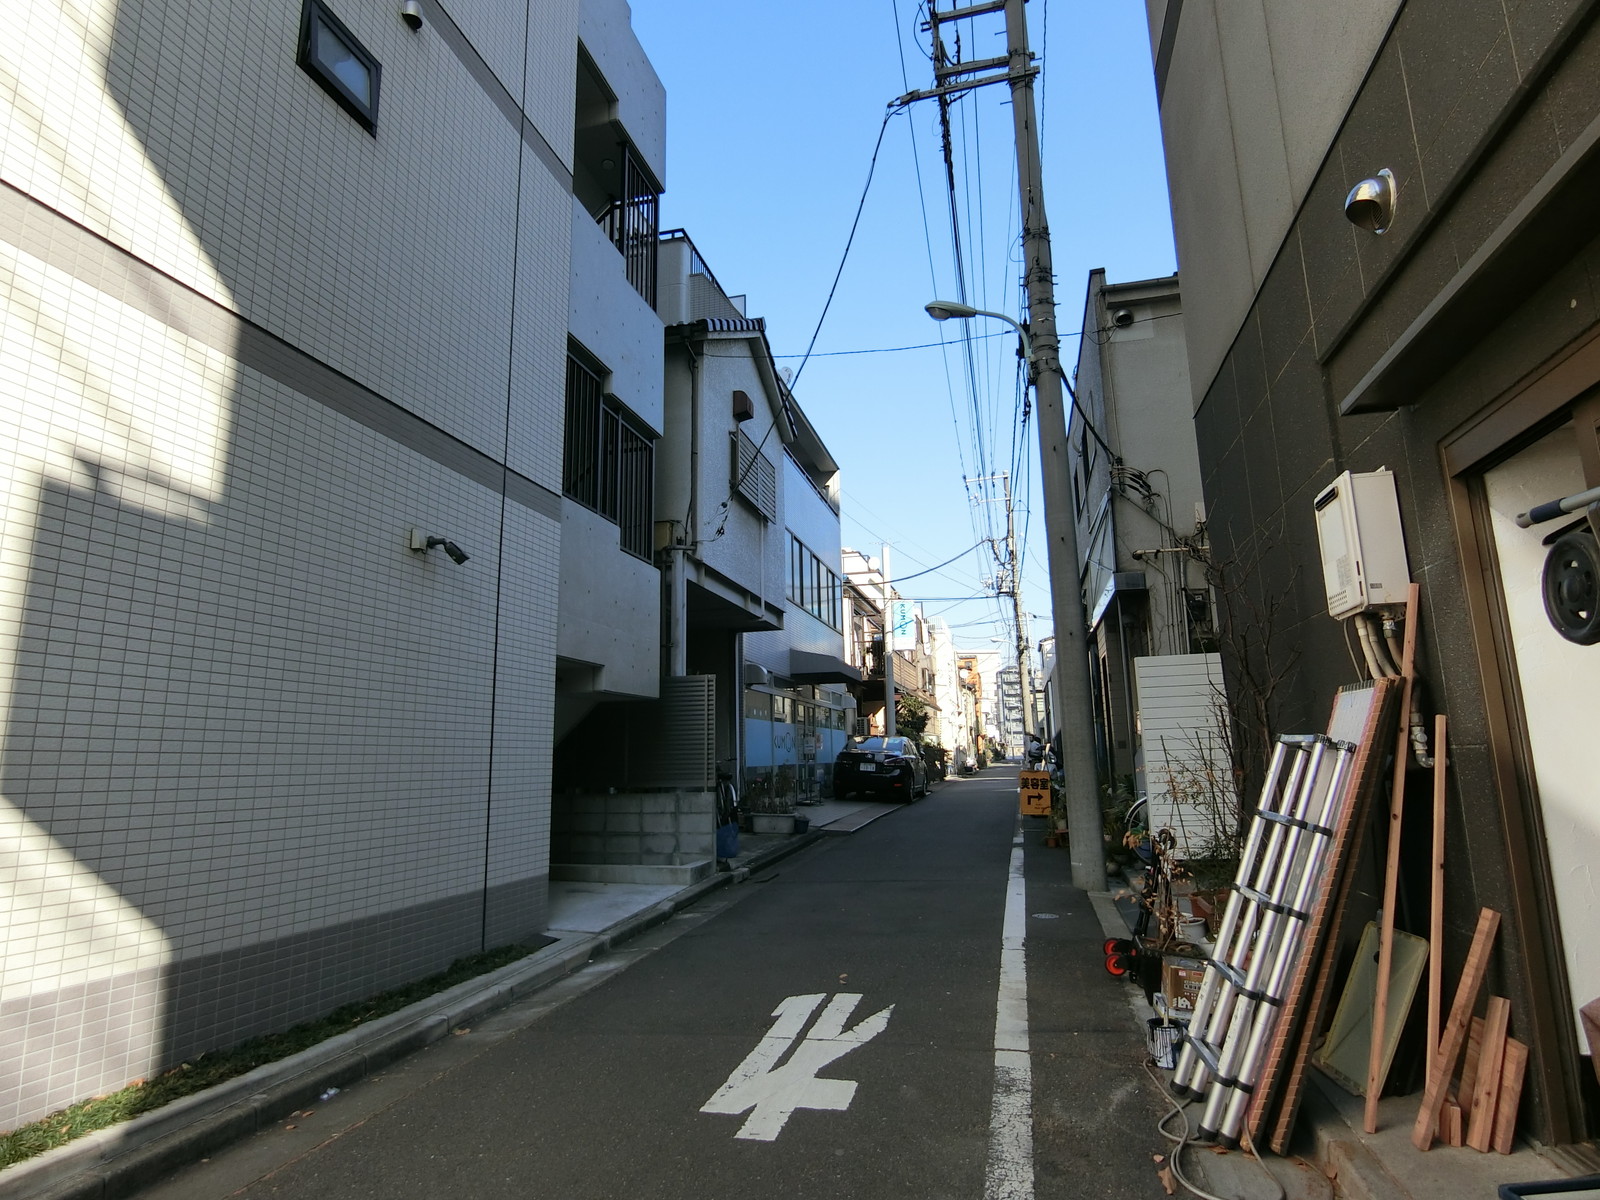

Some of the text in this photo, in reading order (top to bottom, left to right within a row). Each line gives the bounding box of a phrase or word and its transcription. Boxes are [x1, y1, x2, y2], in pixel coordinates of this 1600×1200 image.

[899, 603, 907, 635] KUMON
[773, 732, 796, 753] KUMON
[1021, 777, 1049, 790] 美容室
